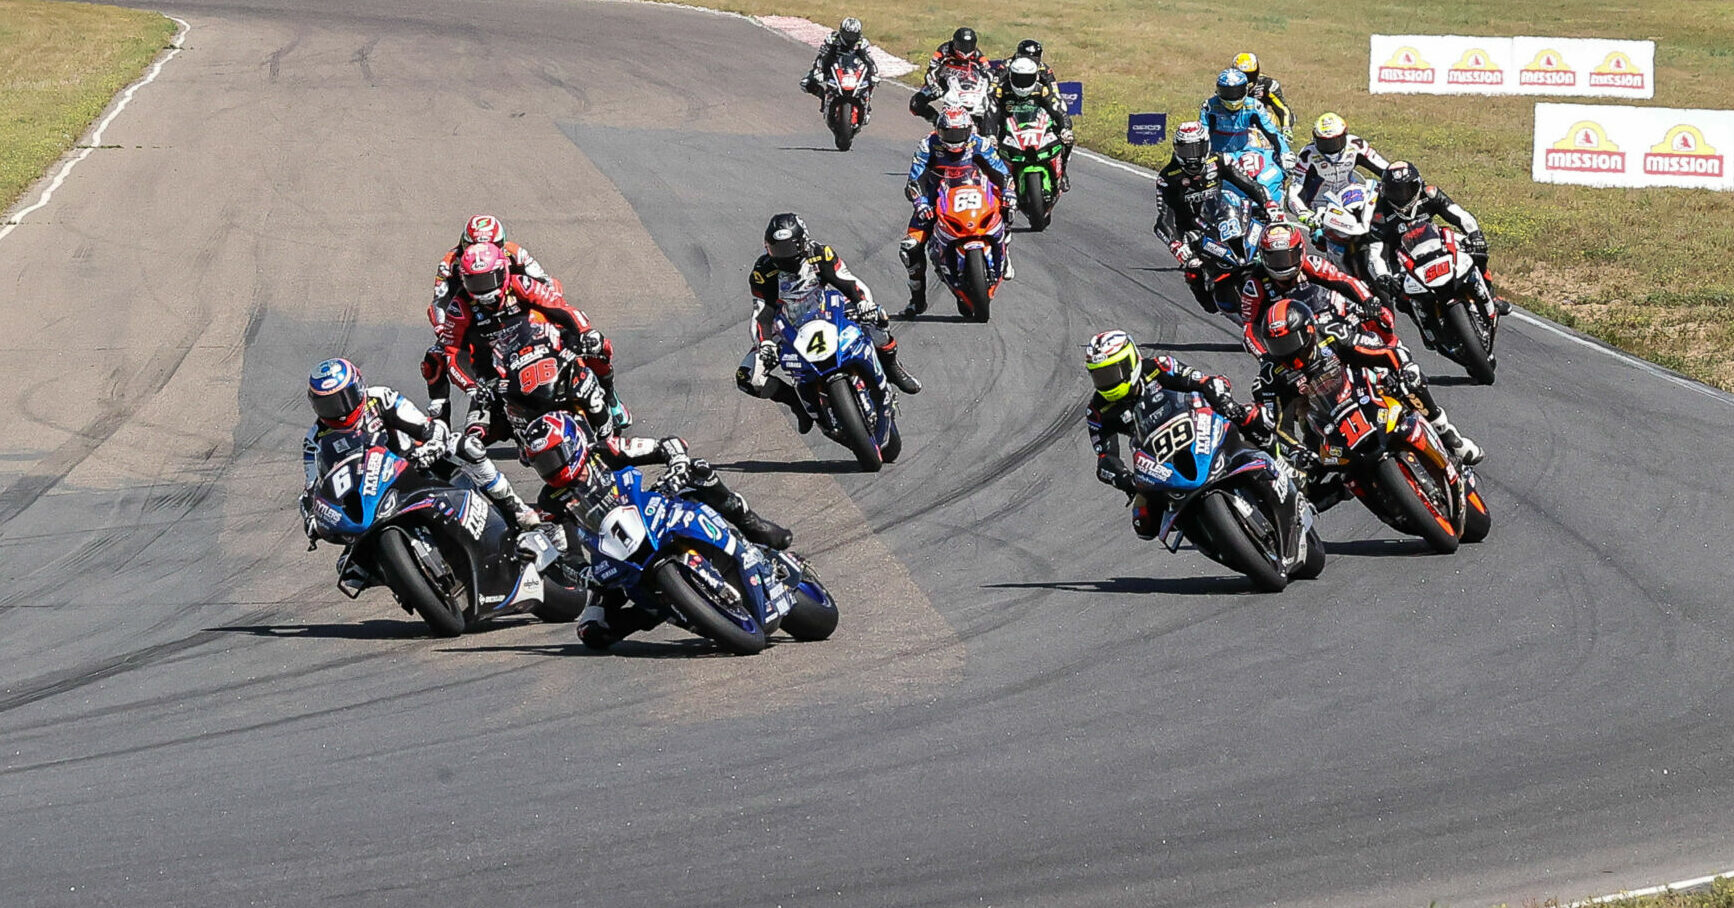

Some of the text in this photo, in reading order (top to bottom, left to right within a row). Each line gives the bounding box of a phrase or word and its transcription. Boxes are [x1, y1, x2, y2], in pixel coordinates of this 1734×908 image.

[1381, 67, 1433, 82] MISSION
[1448, 70, 1502, 83] MISSION
[1521, 71, 1573, 84] MISSION
[1590, 74, 1642, 87] MISSION
[1021, 133, 1039, 146] 71
[1243, 155, 1260, 173] 21
[1547, 152, 1623, 170] MISSION
[1645, 156, 1720, 174] MISSION
[953, 191, 983, 213] 69
[1218, 217, 1242, 242] 23
[806, 329, 827, 355] 4
[518, 357, 558, 395] 96
[1152, 417, 1195, 464] 99
[1339, 409, 1376, 450] 11
[1137, 455, 1173, 478] TYTLERS
[331, 464, 352, 499] 6
[315, 499, 342, 522] TYTLERS
